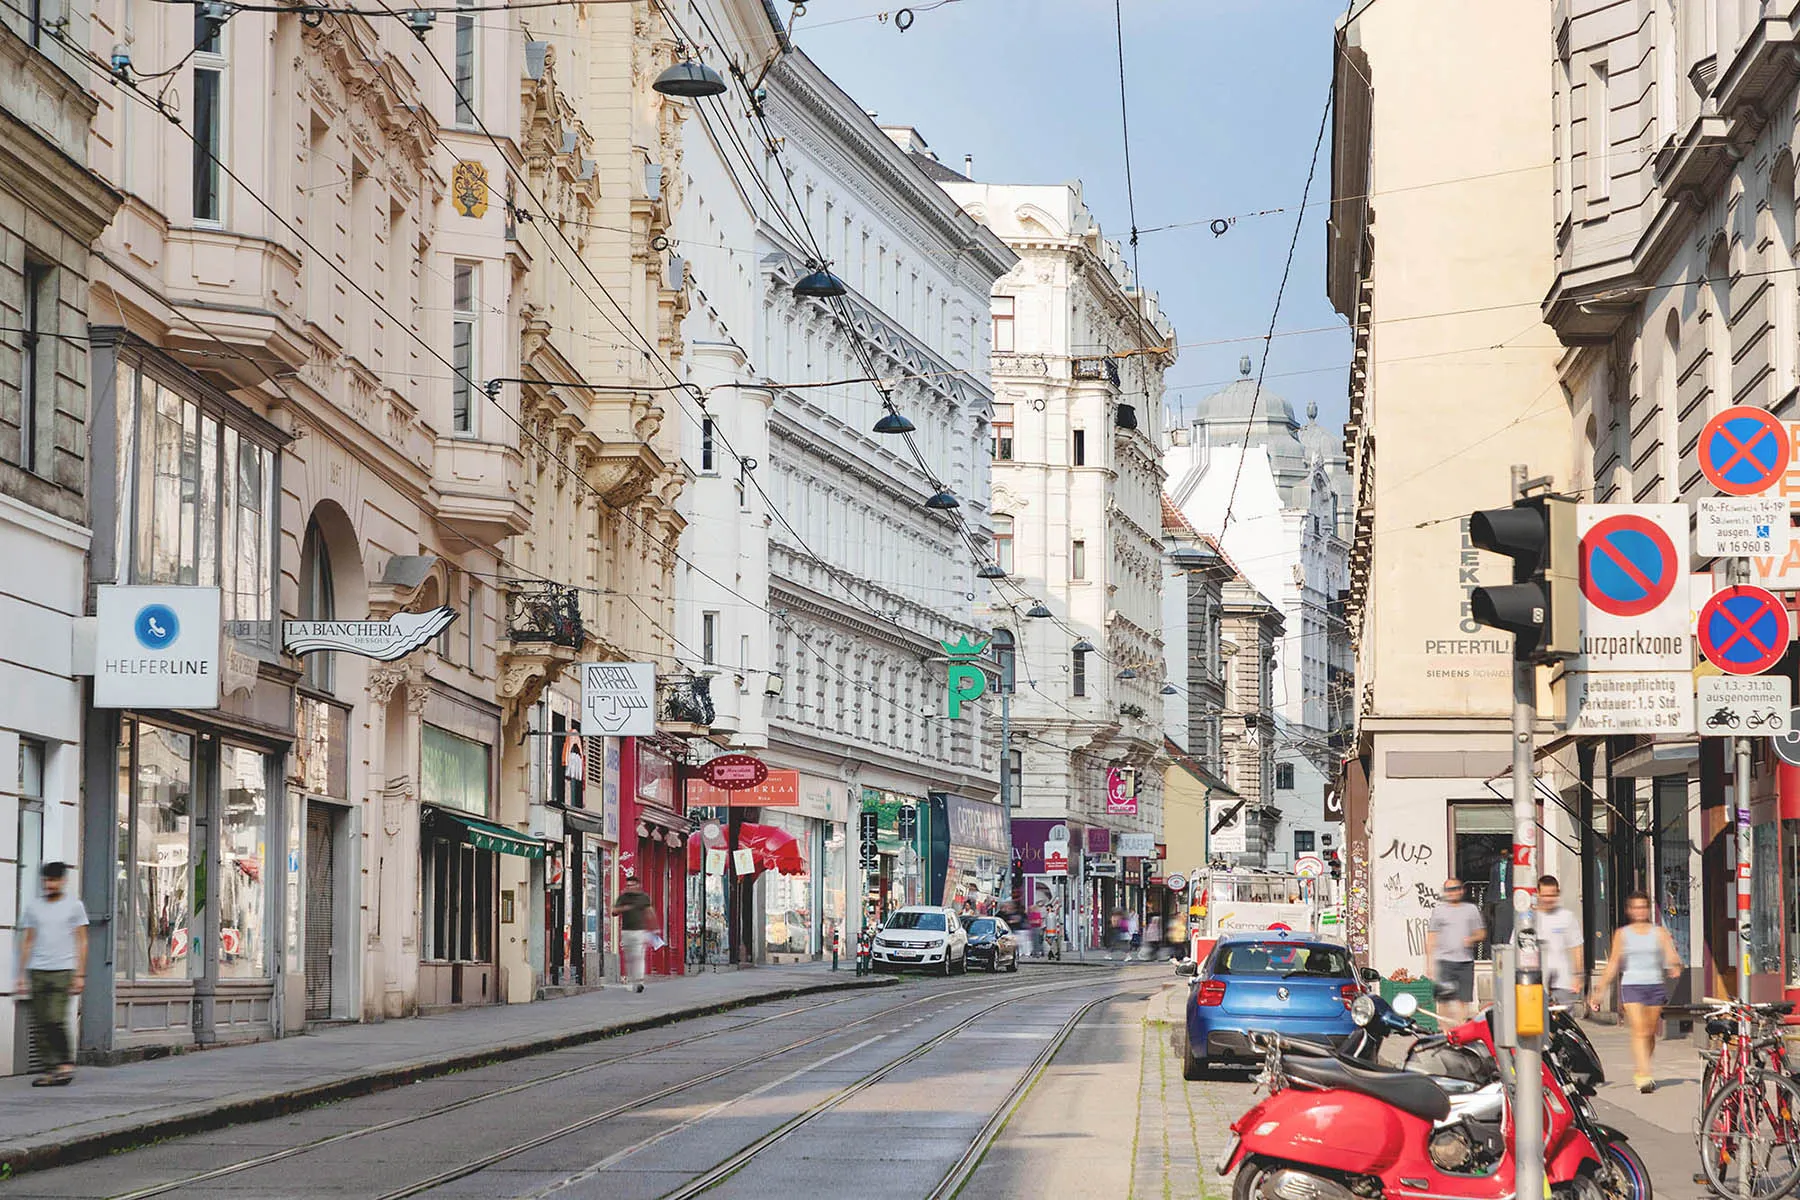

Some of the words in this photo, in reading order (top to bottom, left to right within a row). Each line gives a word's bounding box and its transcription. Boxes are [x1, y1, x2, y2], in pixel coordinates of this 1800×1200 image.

[1717, 541, 1726, 552] W
[288, 623, 308, 636] LA
[311, 623, 403, 637] BIANCHERIA
[354, 637, 392, 645] DESSOUS
[105, 659, 209, 675] HELFERLINE
[1426, 669, 1471, 678] SIEMENS
[1583, 678, 1676, 696] gebührenpflichtig
[1706, 693, 1782, 704] ausgenommen
